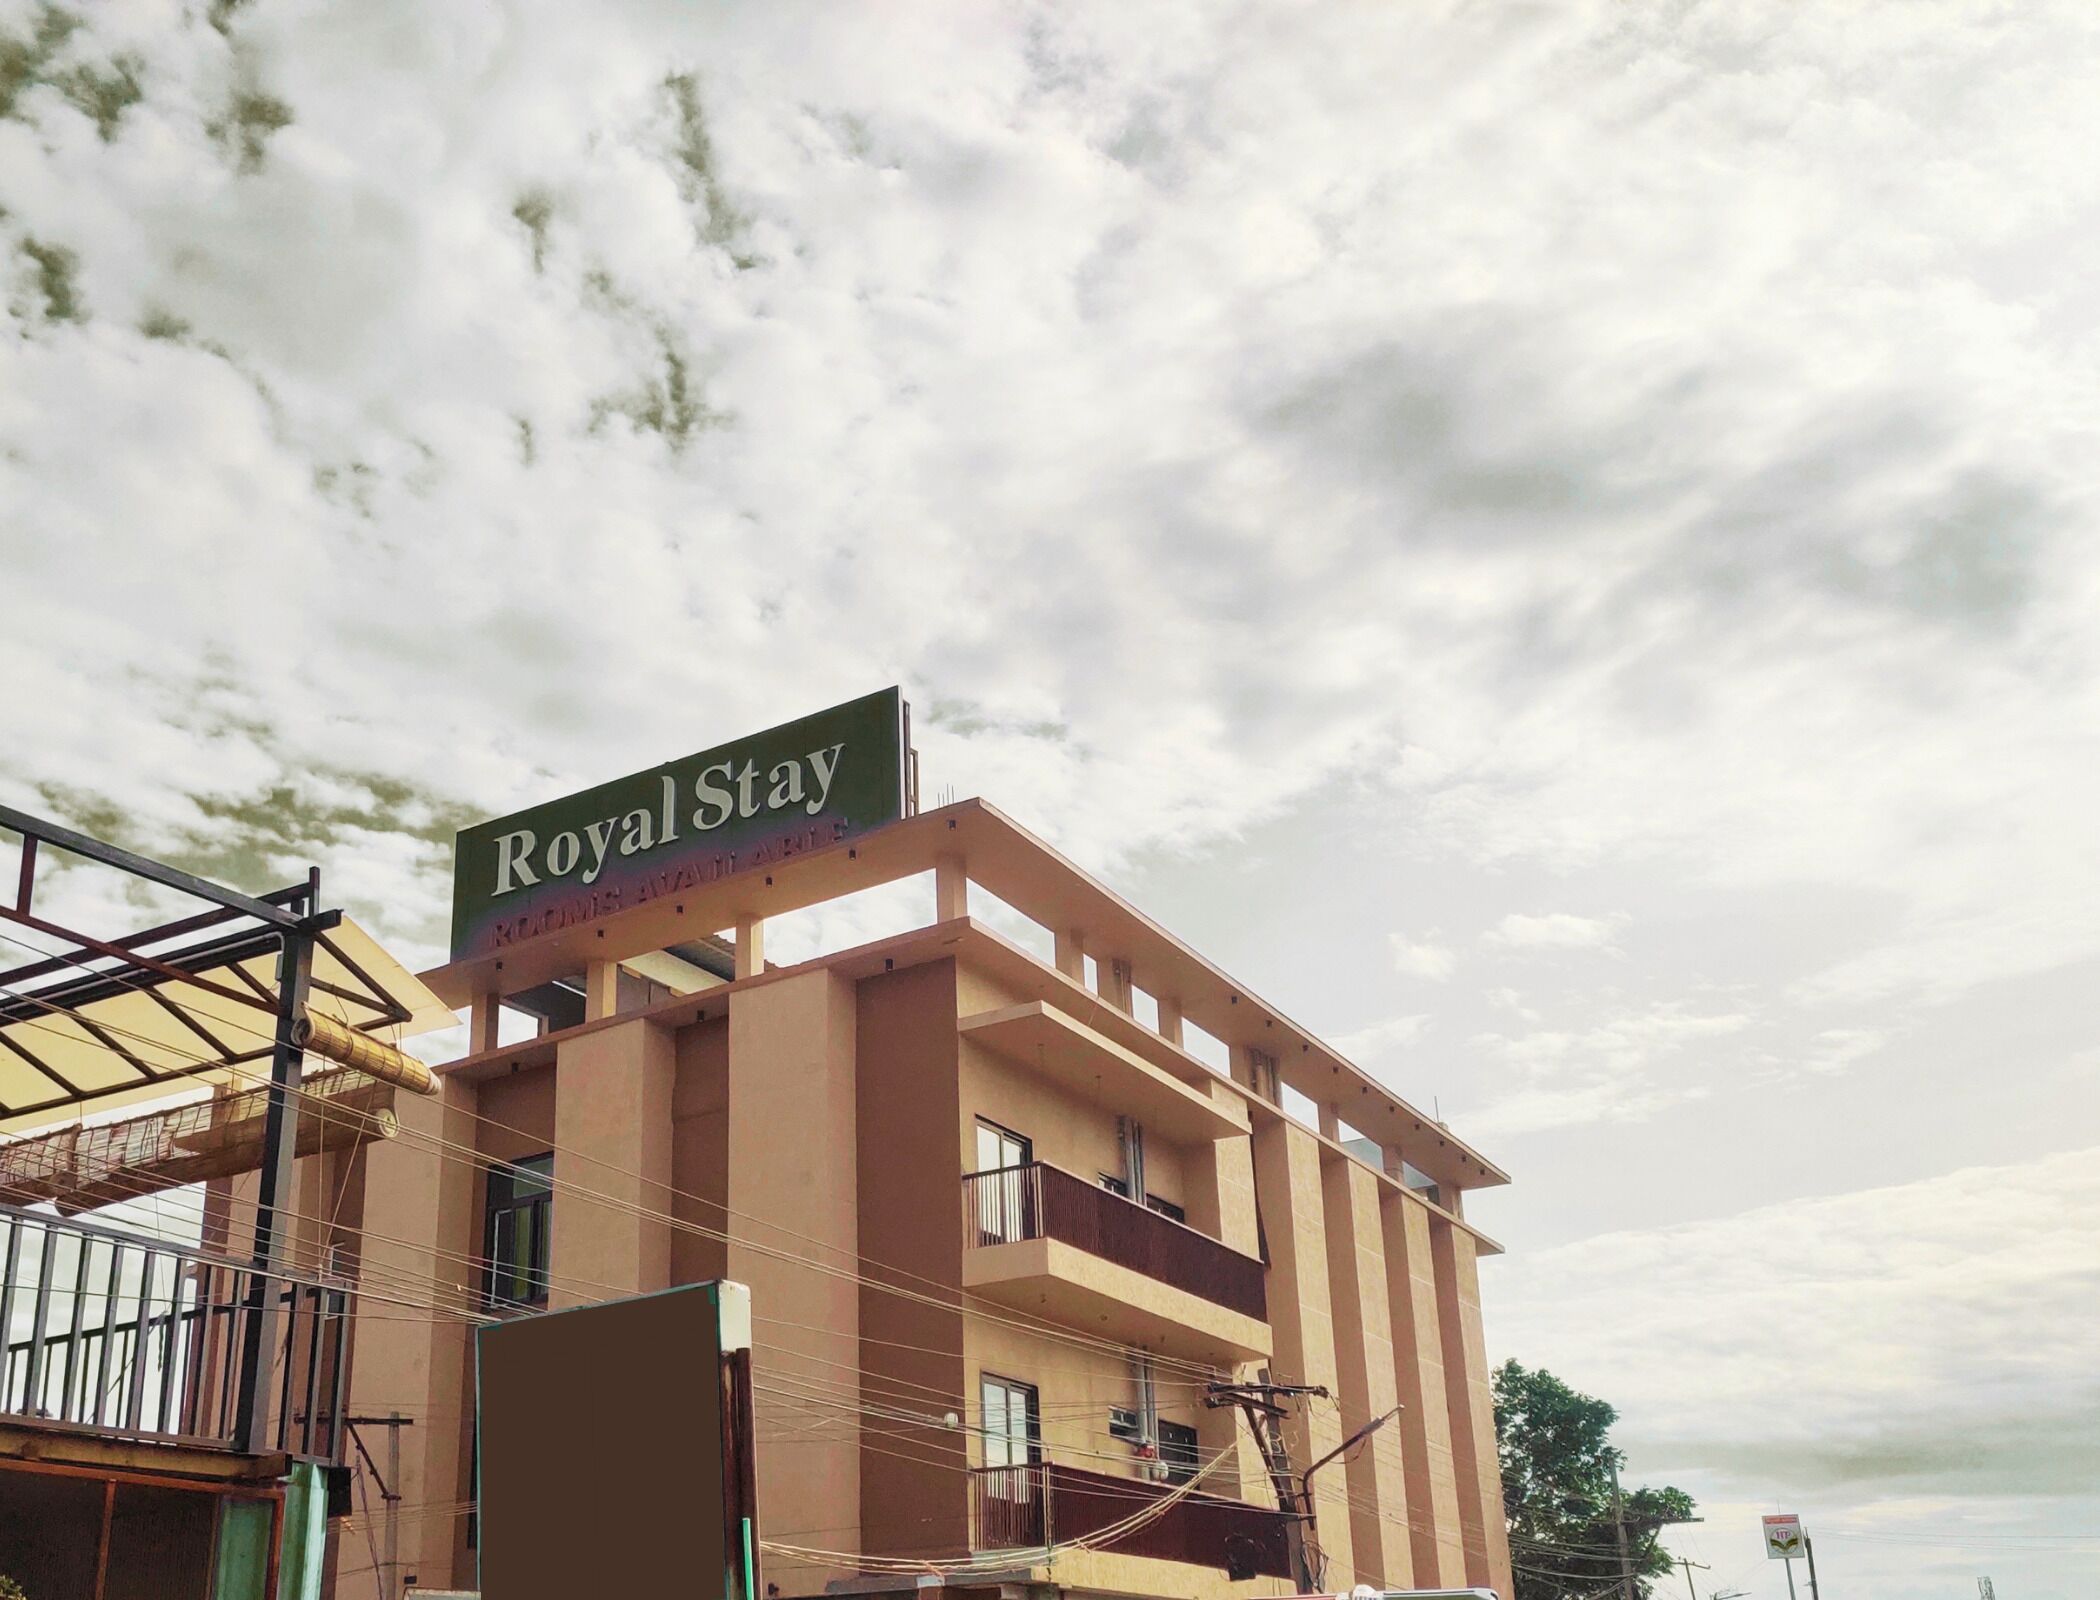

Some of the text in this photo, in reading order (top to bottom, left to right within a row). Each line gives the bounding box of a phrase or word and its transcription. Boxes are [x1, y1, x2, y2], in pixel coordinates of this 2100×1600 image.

[491, 742, 846, 896] Royal Stay
[1775, 1531, 1791, 1540] HP
